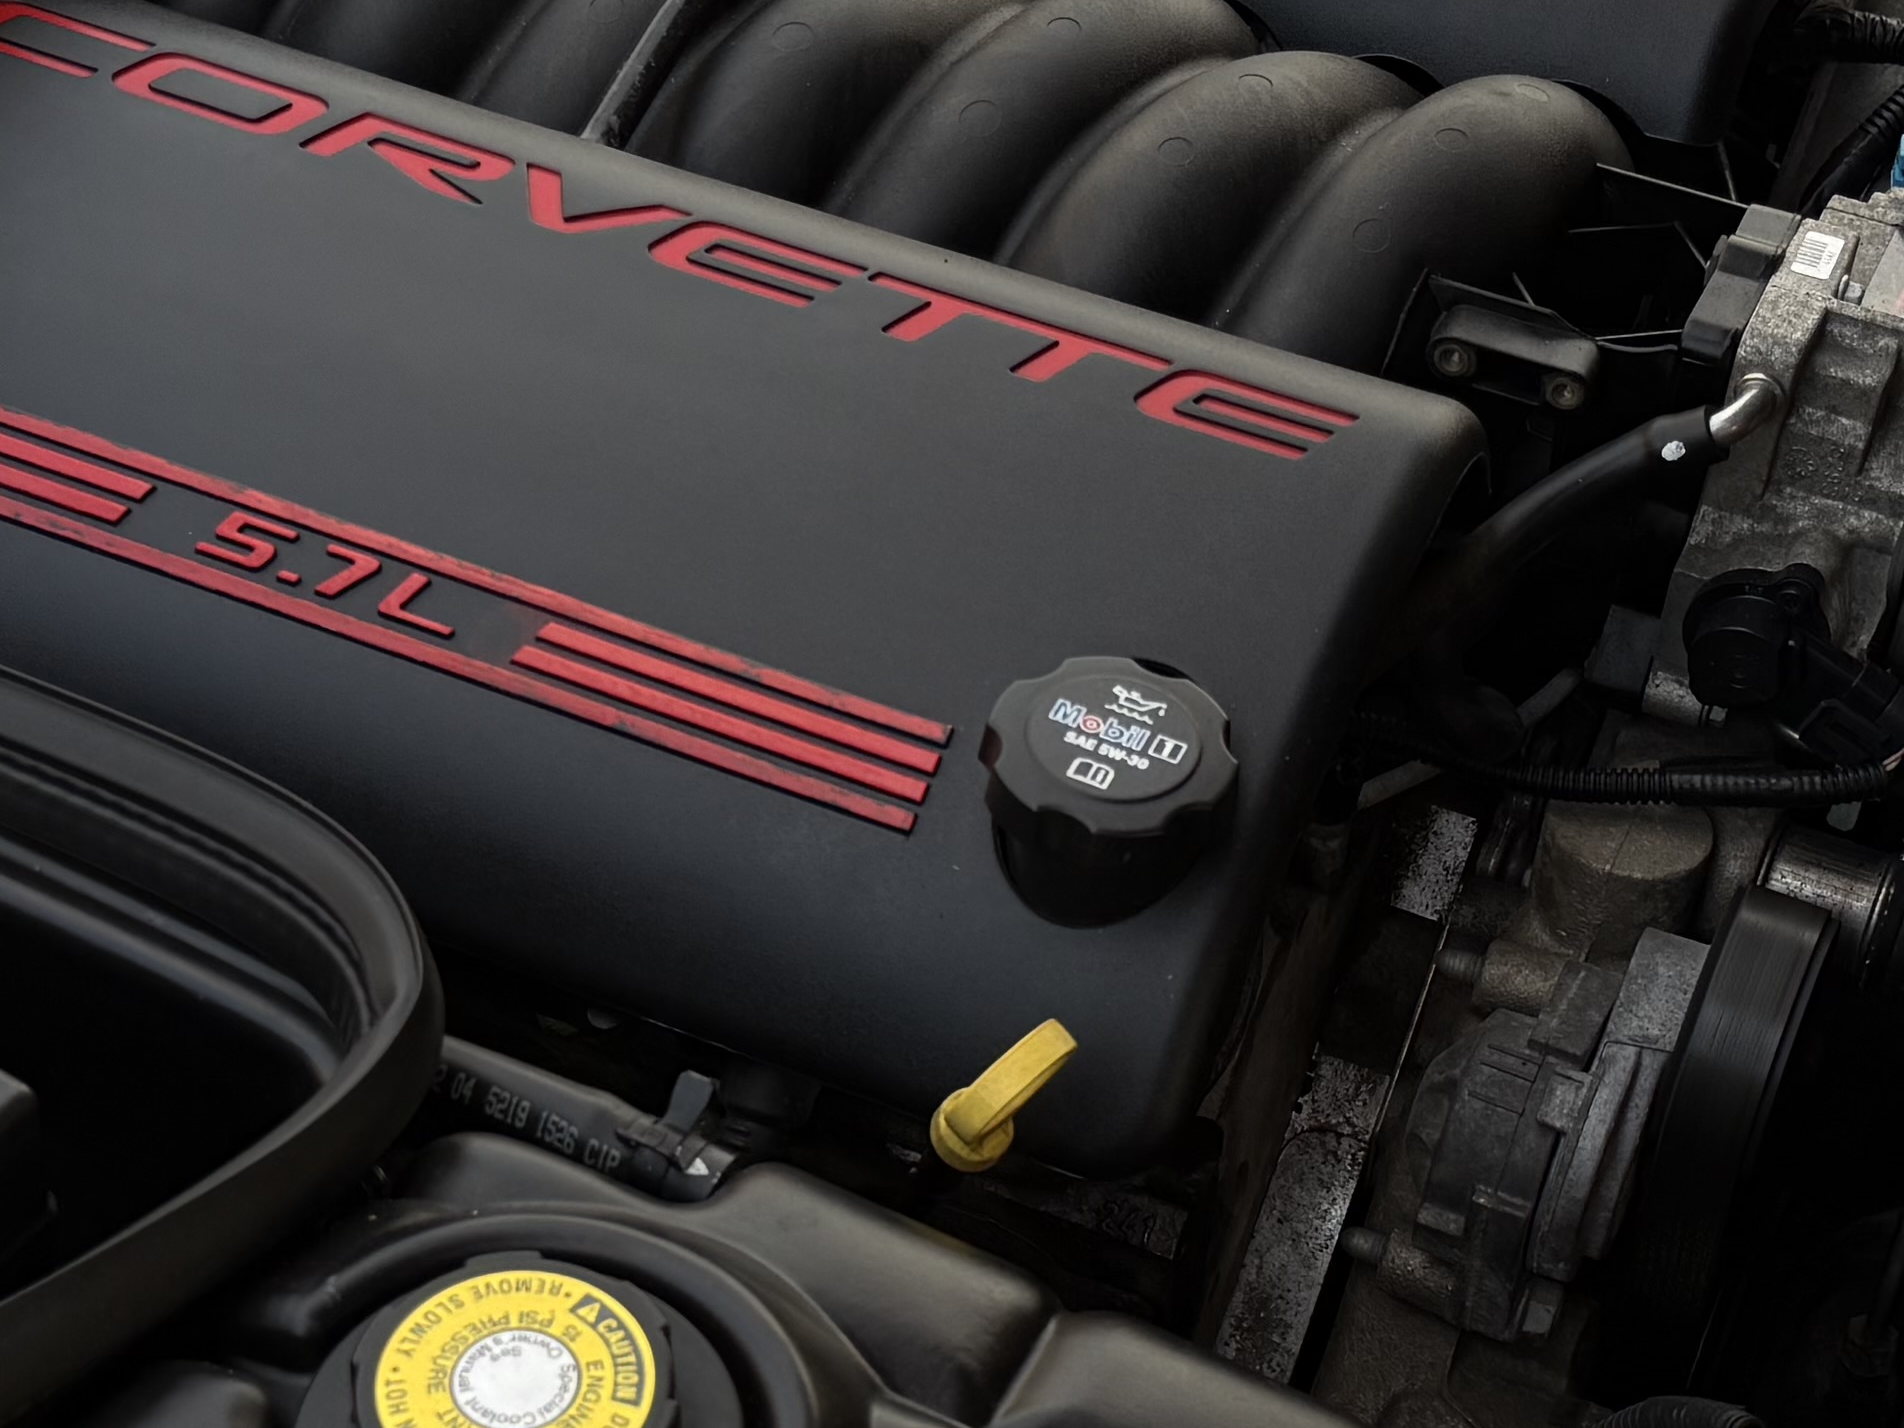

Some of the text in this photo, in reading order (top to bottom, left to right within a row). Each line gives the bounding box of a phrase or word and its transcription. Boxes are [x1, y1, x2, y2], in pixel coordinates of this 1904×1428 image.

[194, 510, 456, 638] 5.7L
[1049, 698, 1151, 751] Mobil
[1063, 731, 1150, 770] SAE 5W-30
[535, 1110, 580, 1155] 1526
[396, 1277, 564, 1359] REMOVE SLOWLY
[517, 1309, 556, 1328] PSI
[426, 1311, 510, 1394] PRESSURE
[458, 1335, 563, 1393] Owner's Manual
[490, 1346, 522, 1362] See
[598, 1318, 640, 1400] CAUTION
[384, 1378, 409, 1415] HOT
[467, 1364, 577, 1425] Special Coolant
